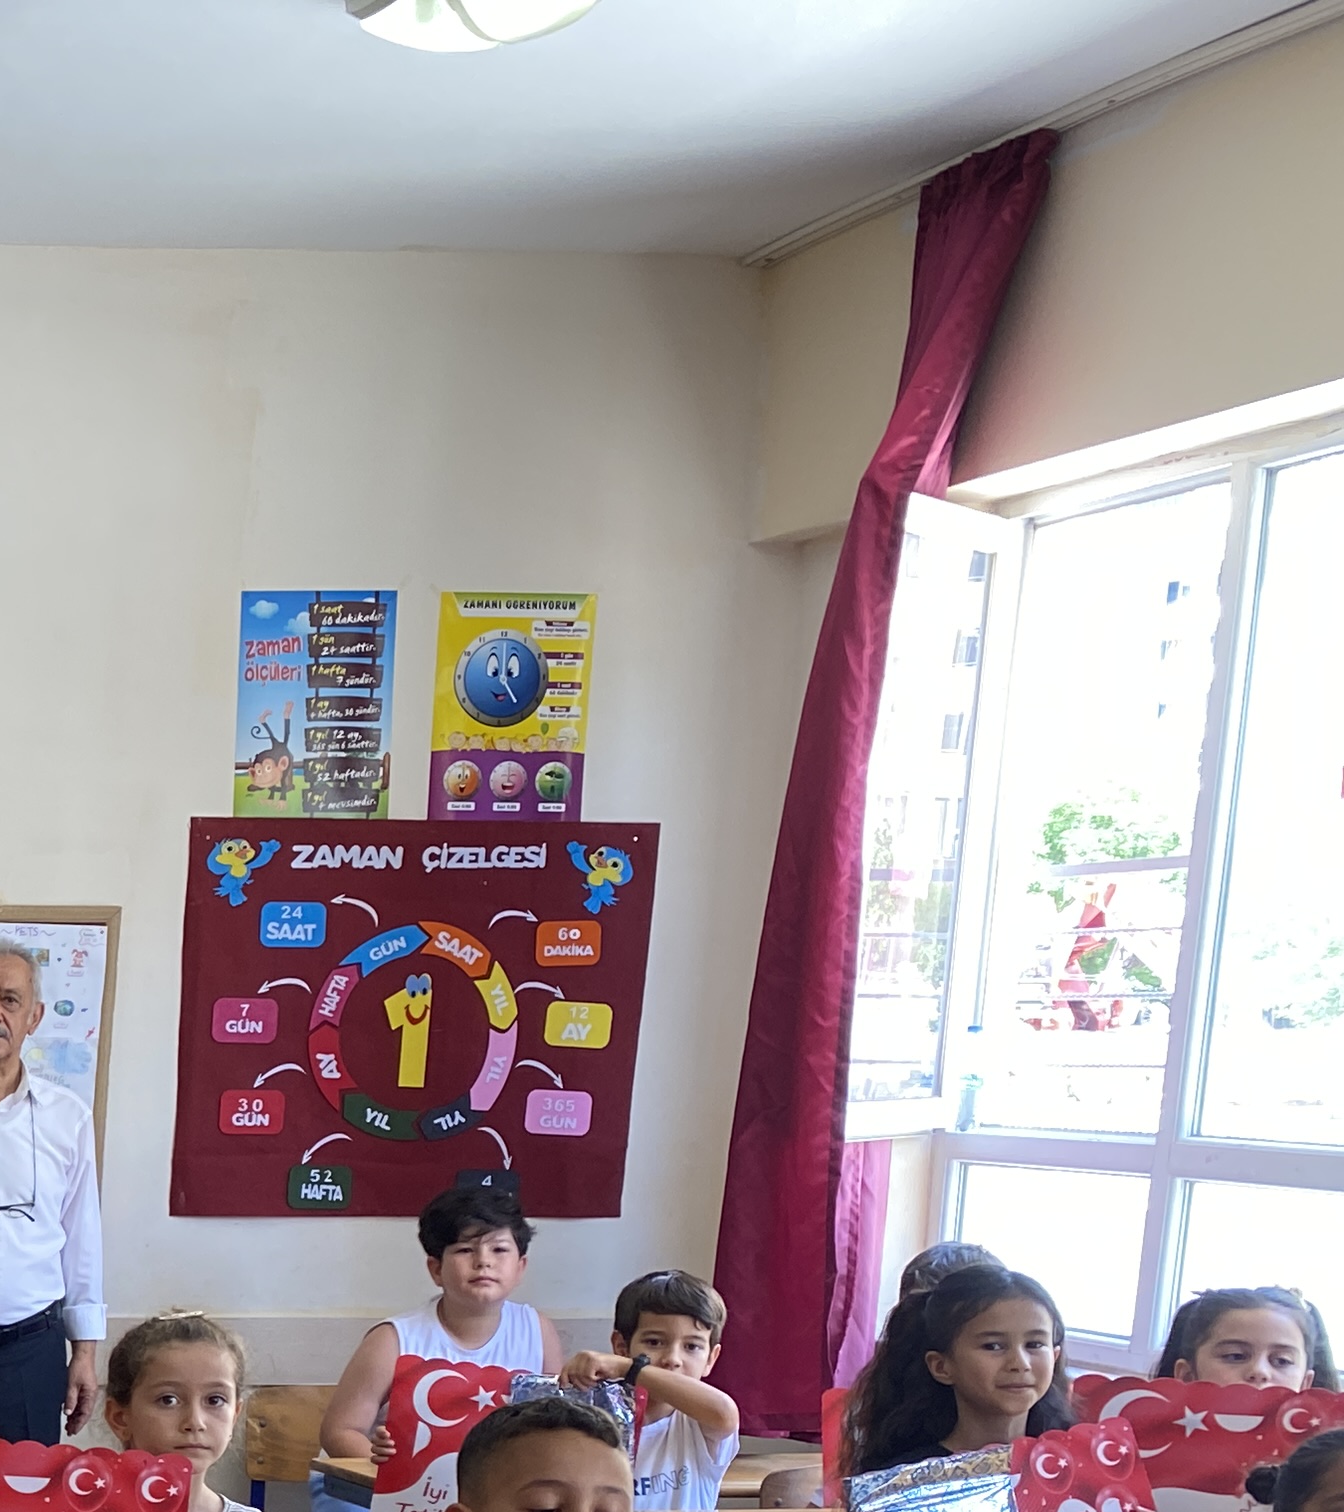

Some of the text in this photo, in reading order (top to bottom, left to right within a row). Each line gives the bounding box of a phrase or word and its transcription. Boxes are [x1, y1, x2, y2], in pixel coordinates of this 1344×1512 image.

[244, 661, 302, 686] ölçüleri
[290, 842, 547, 873] ZAMAN ÇİZELGESİ
[281, 905, 303, 919] 24
[266, 922, 316, 941] SAAT
[558, 927, 581, 941] 60
[369, 936, 407, 961] GÜN
[434, 931, 483, 966] SAAT
[544, 943, 594, 957] DAKİKA
[319, 974, 349, 1017] HAFTA
[491, 984, 509, 1016] YIL
[240, 1004, 250, 1017] 7
[569, 1006, 589, 1019] 12
[225, 1018, 263, 1034] GÜN
[560, 1023, 592, 1041] AY
[316, 1053, 341, 1079] AY
[486, 1056, 507, 1083] YIL
[238, 1098, 263, 1112] 30
[542, 1098, 575, 1112] 365
[231, 1111, 270, 1126] GÜN
[366, 1108, 391, 1130] YIL
[433, 1110, 466, 1131] YIL
[539, 1114, 577, 1129] GÜN
[310, 1169, 332, 1182] 52
[481, 1175, 492, 1186] 4
[300, 1183, 343, 1201] HAFTA
[423, 1476, 450, 1504] İyi
[633, 1466, 689, 1496] RFING
